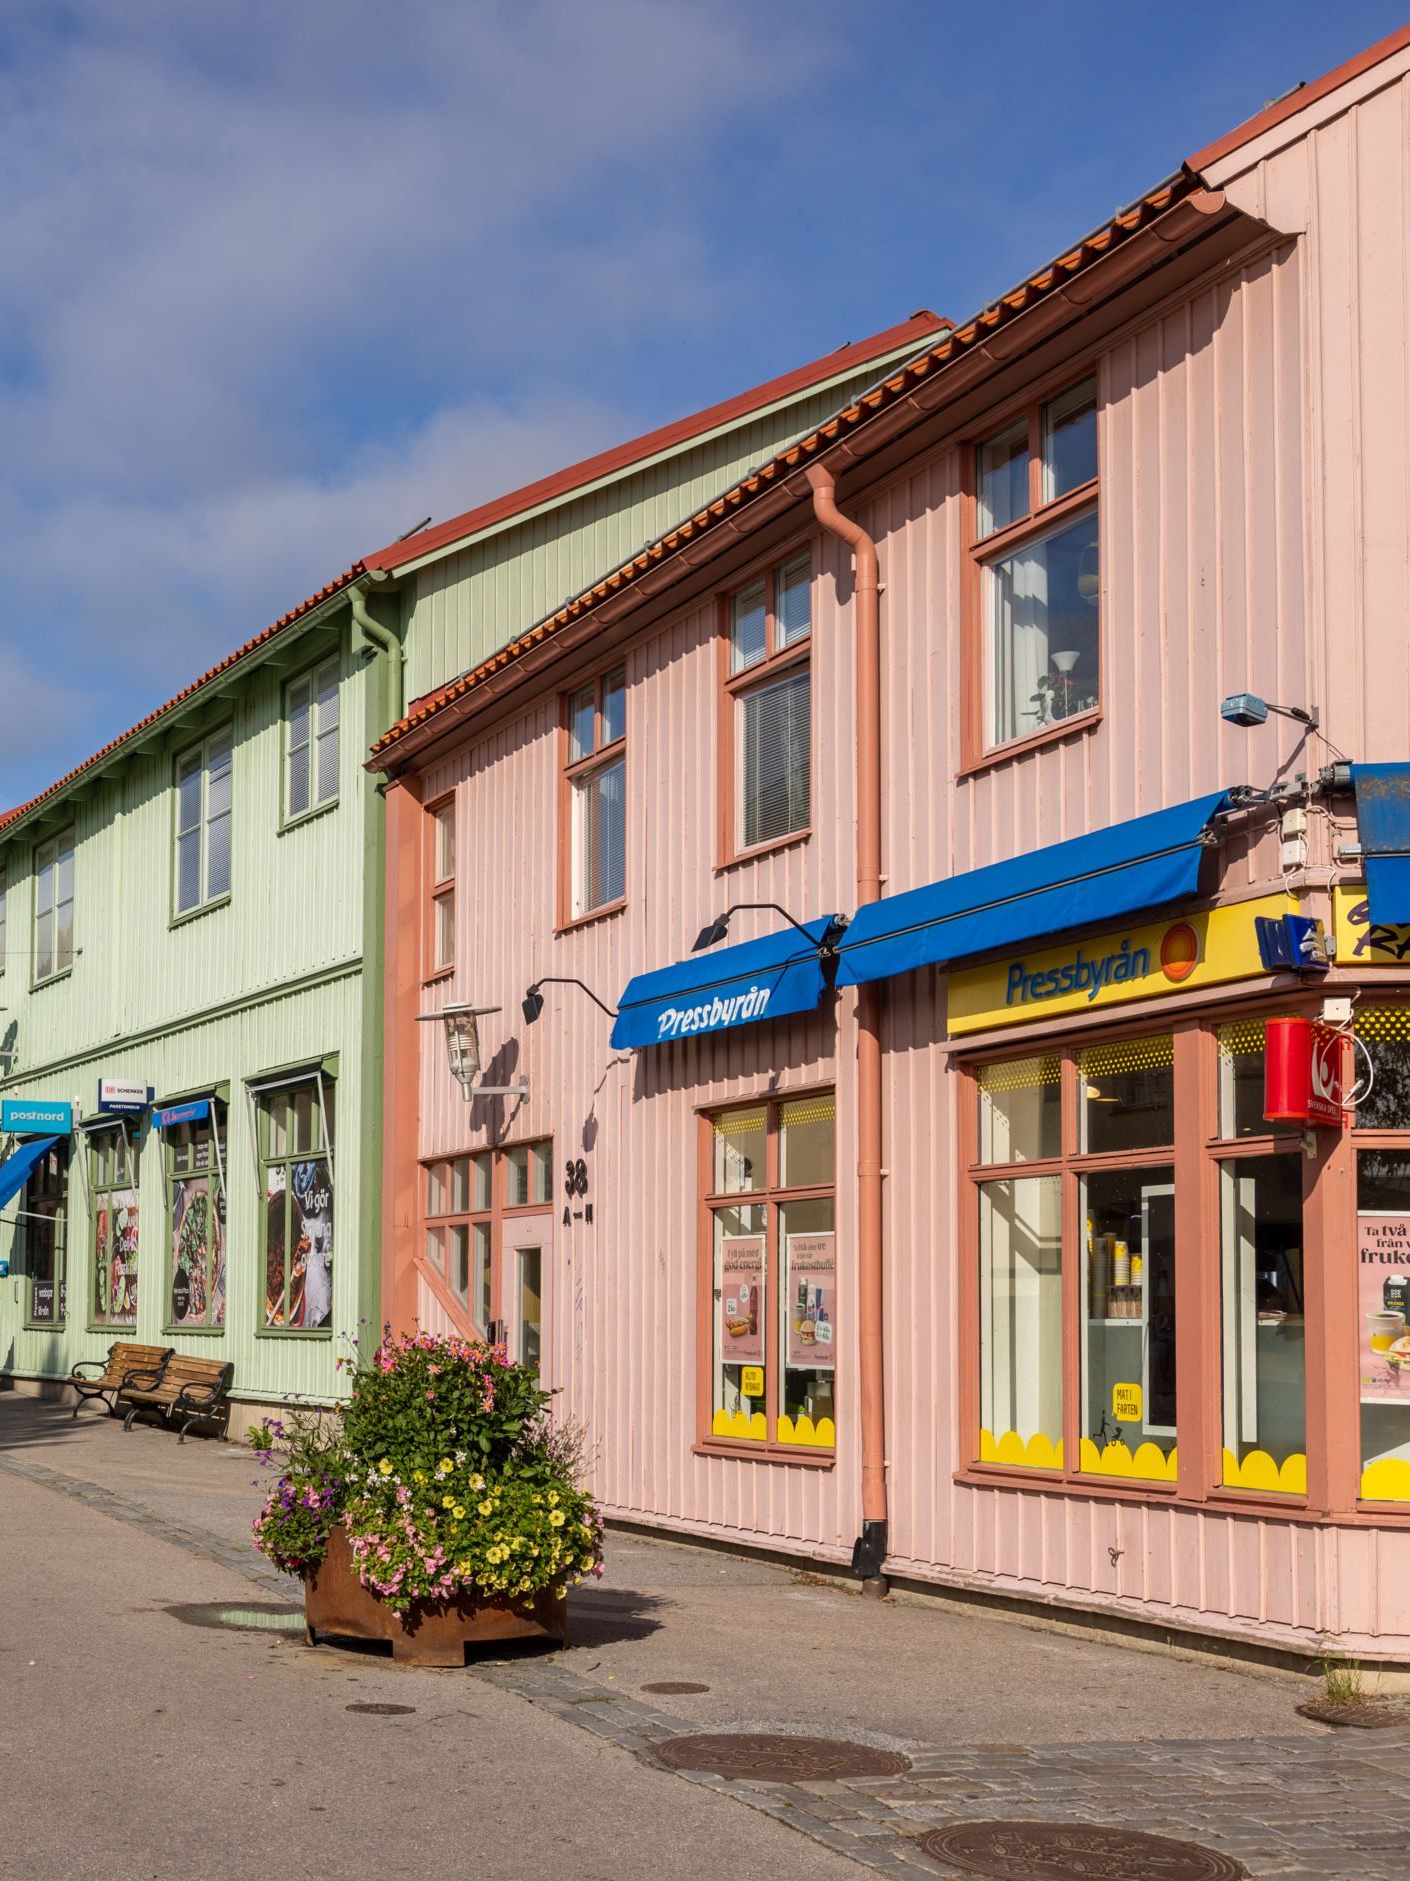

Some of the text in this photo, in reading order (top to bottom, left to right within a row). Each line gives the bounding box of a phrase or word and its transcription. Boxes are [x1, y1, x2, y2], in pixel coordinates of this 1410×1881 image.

[1006, 939, 1150, 1005] Pressbyrån
[657, 986, 771, 1039] Pressbyrån
[10, 1111, 65, 1121] postnord
[565, 1158, 588, 1200] 38
[305, 1188, 329, 1213] Vi gör
[1364, 1223, 1407, 1237] Ta två
[1377, 1238, 1403, 1248] från
[1116, 1389, 1128, 1400] MAT
[1116, 1403, 1138, 1415] FARTEN
